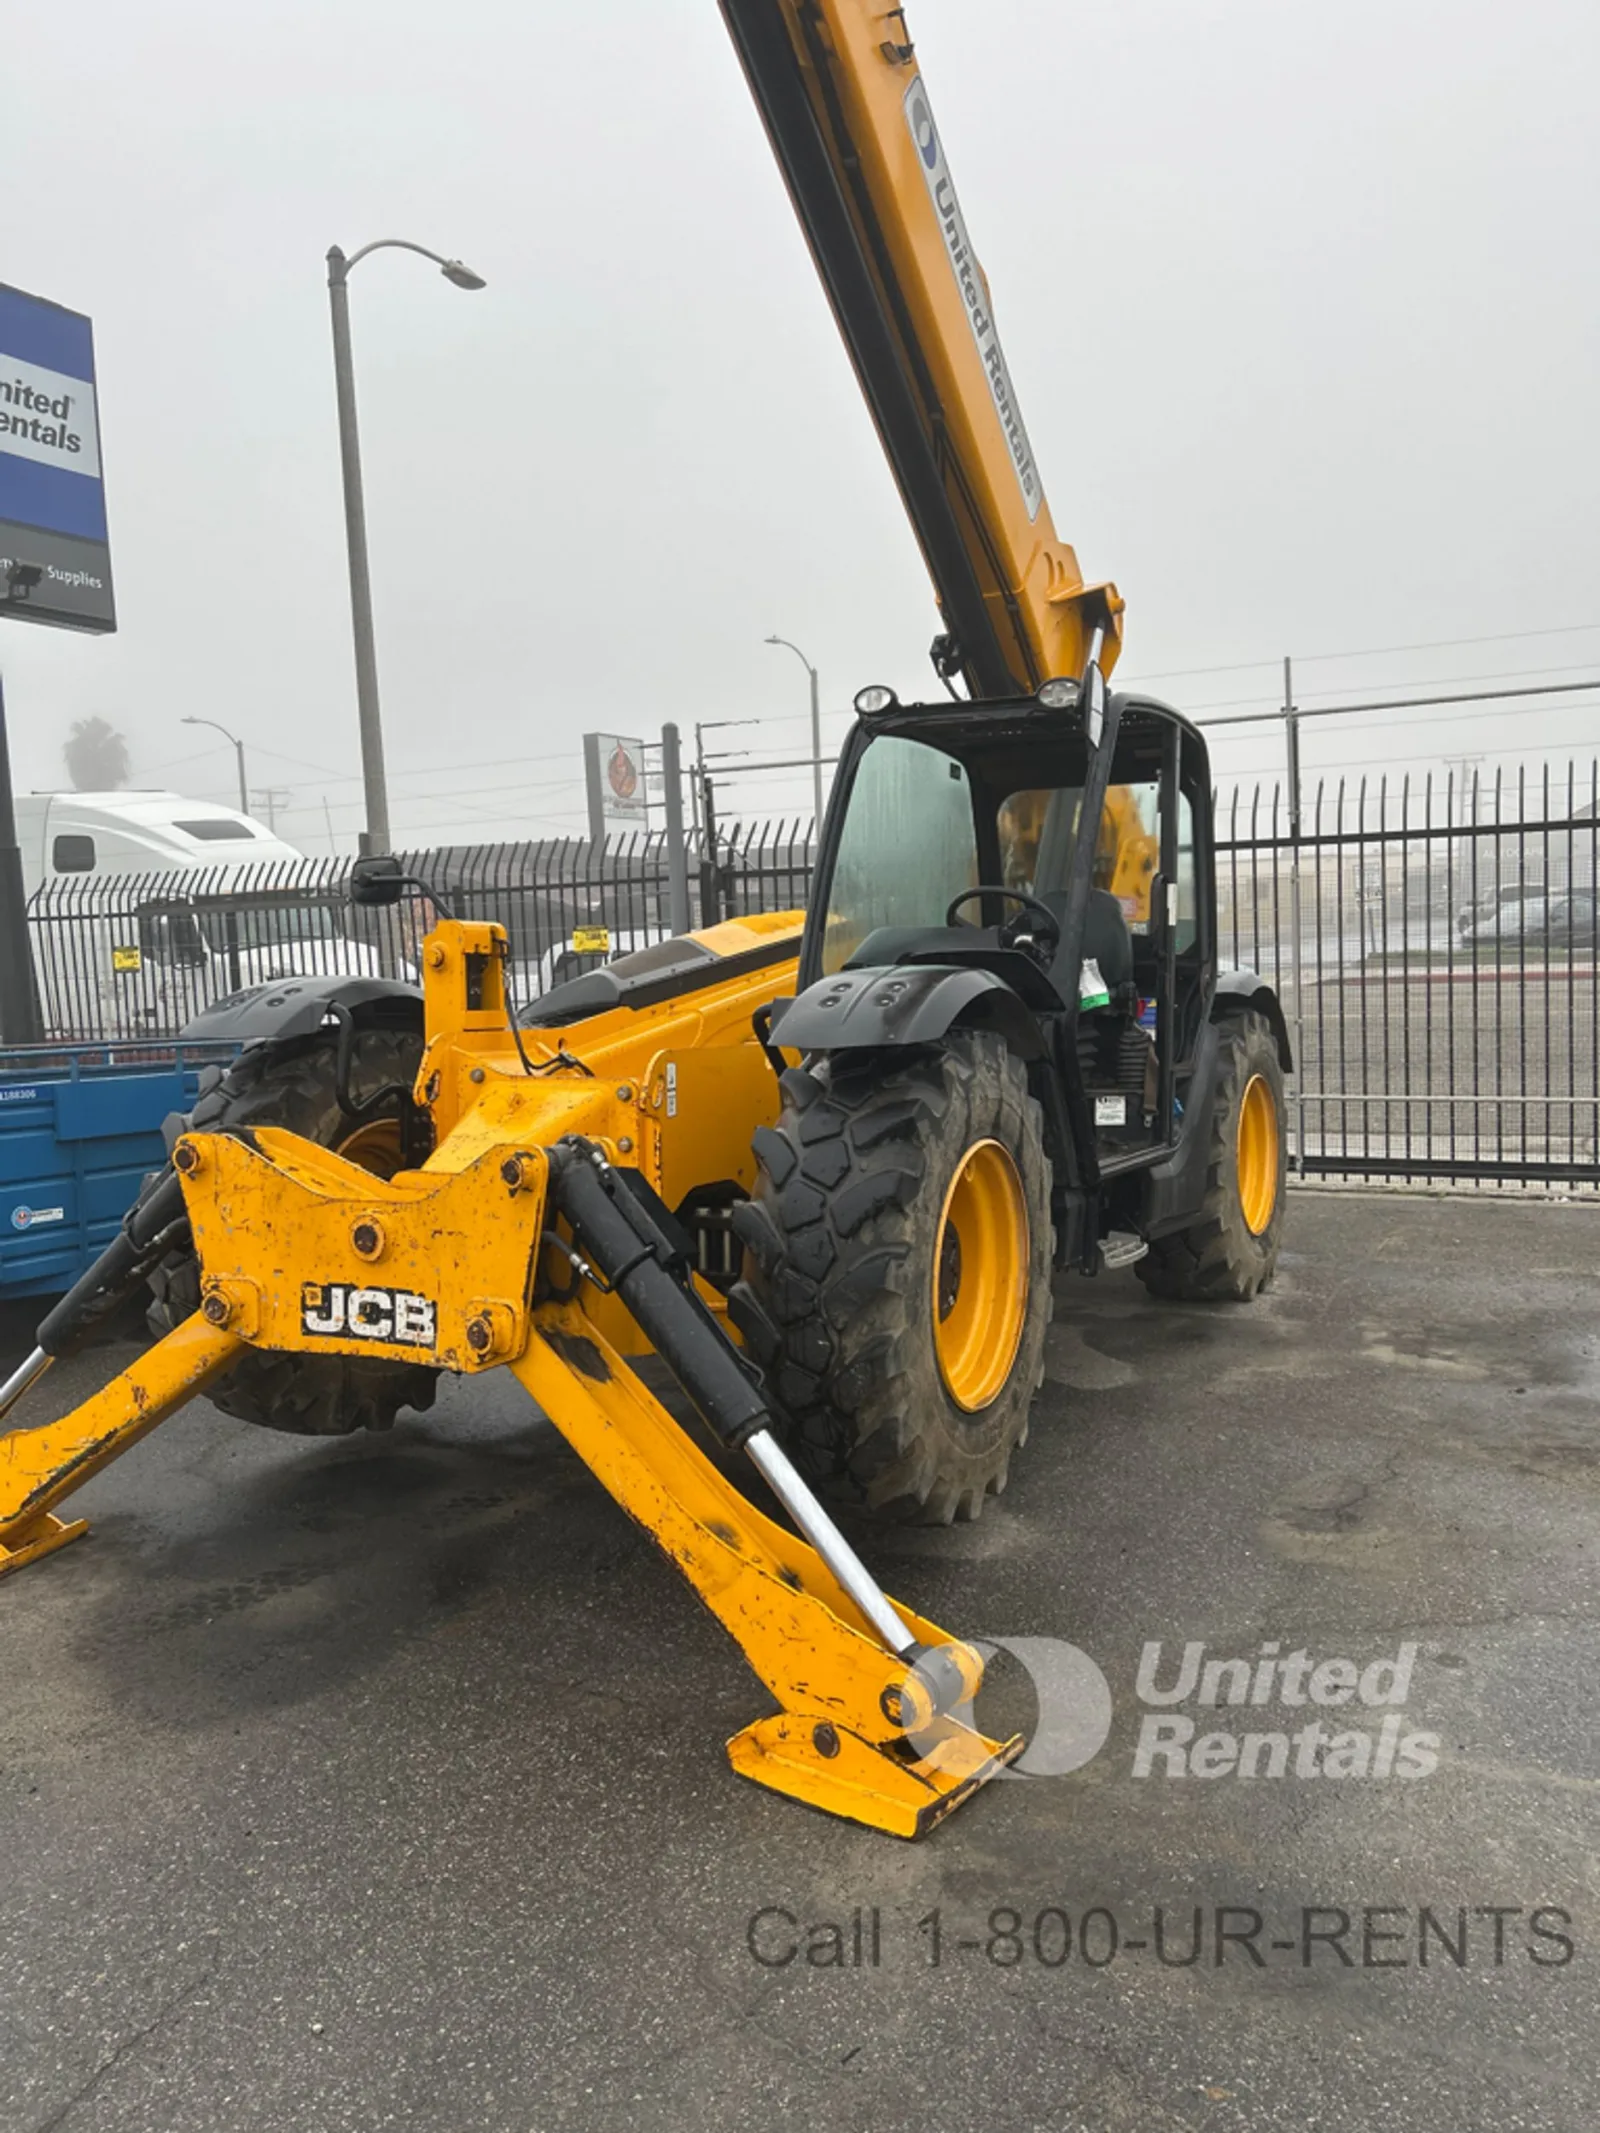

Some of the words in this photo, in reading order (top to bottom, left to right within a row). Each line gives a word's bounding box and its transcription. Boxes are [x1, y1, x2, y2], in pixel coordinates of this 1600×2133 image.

[935, 177, 990, 338] United
[984, 343, 1034, 497] Rentals
[0, 379, 70, 421] nited
[0, 411, 81, 453] entals
[47, 565, 102, 589] Supplies
[305, 1288, 435, 1344] JCB
